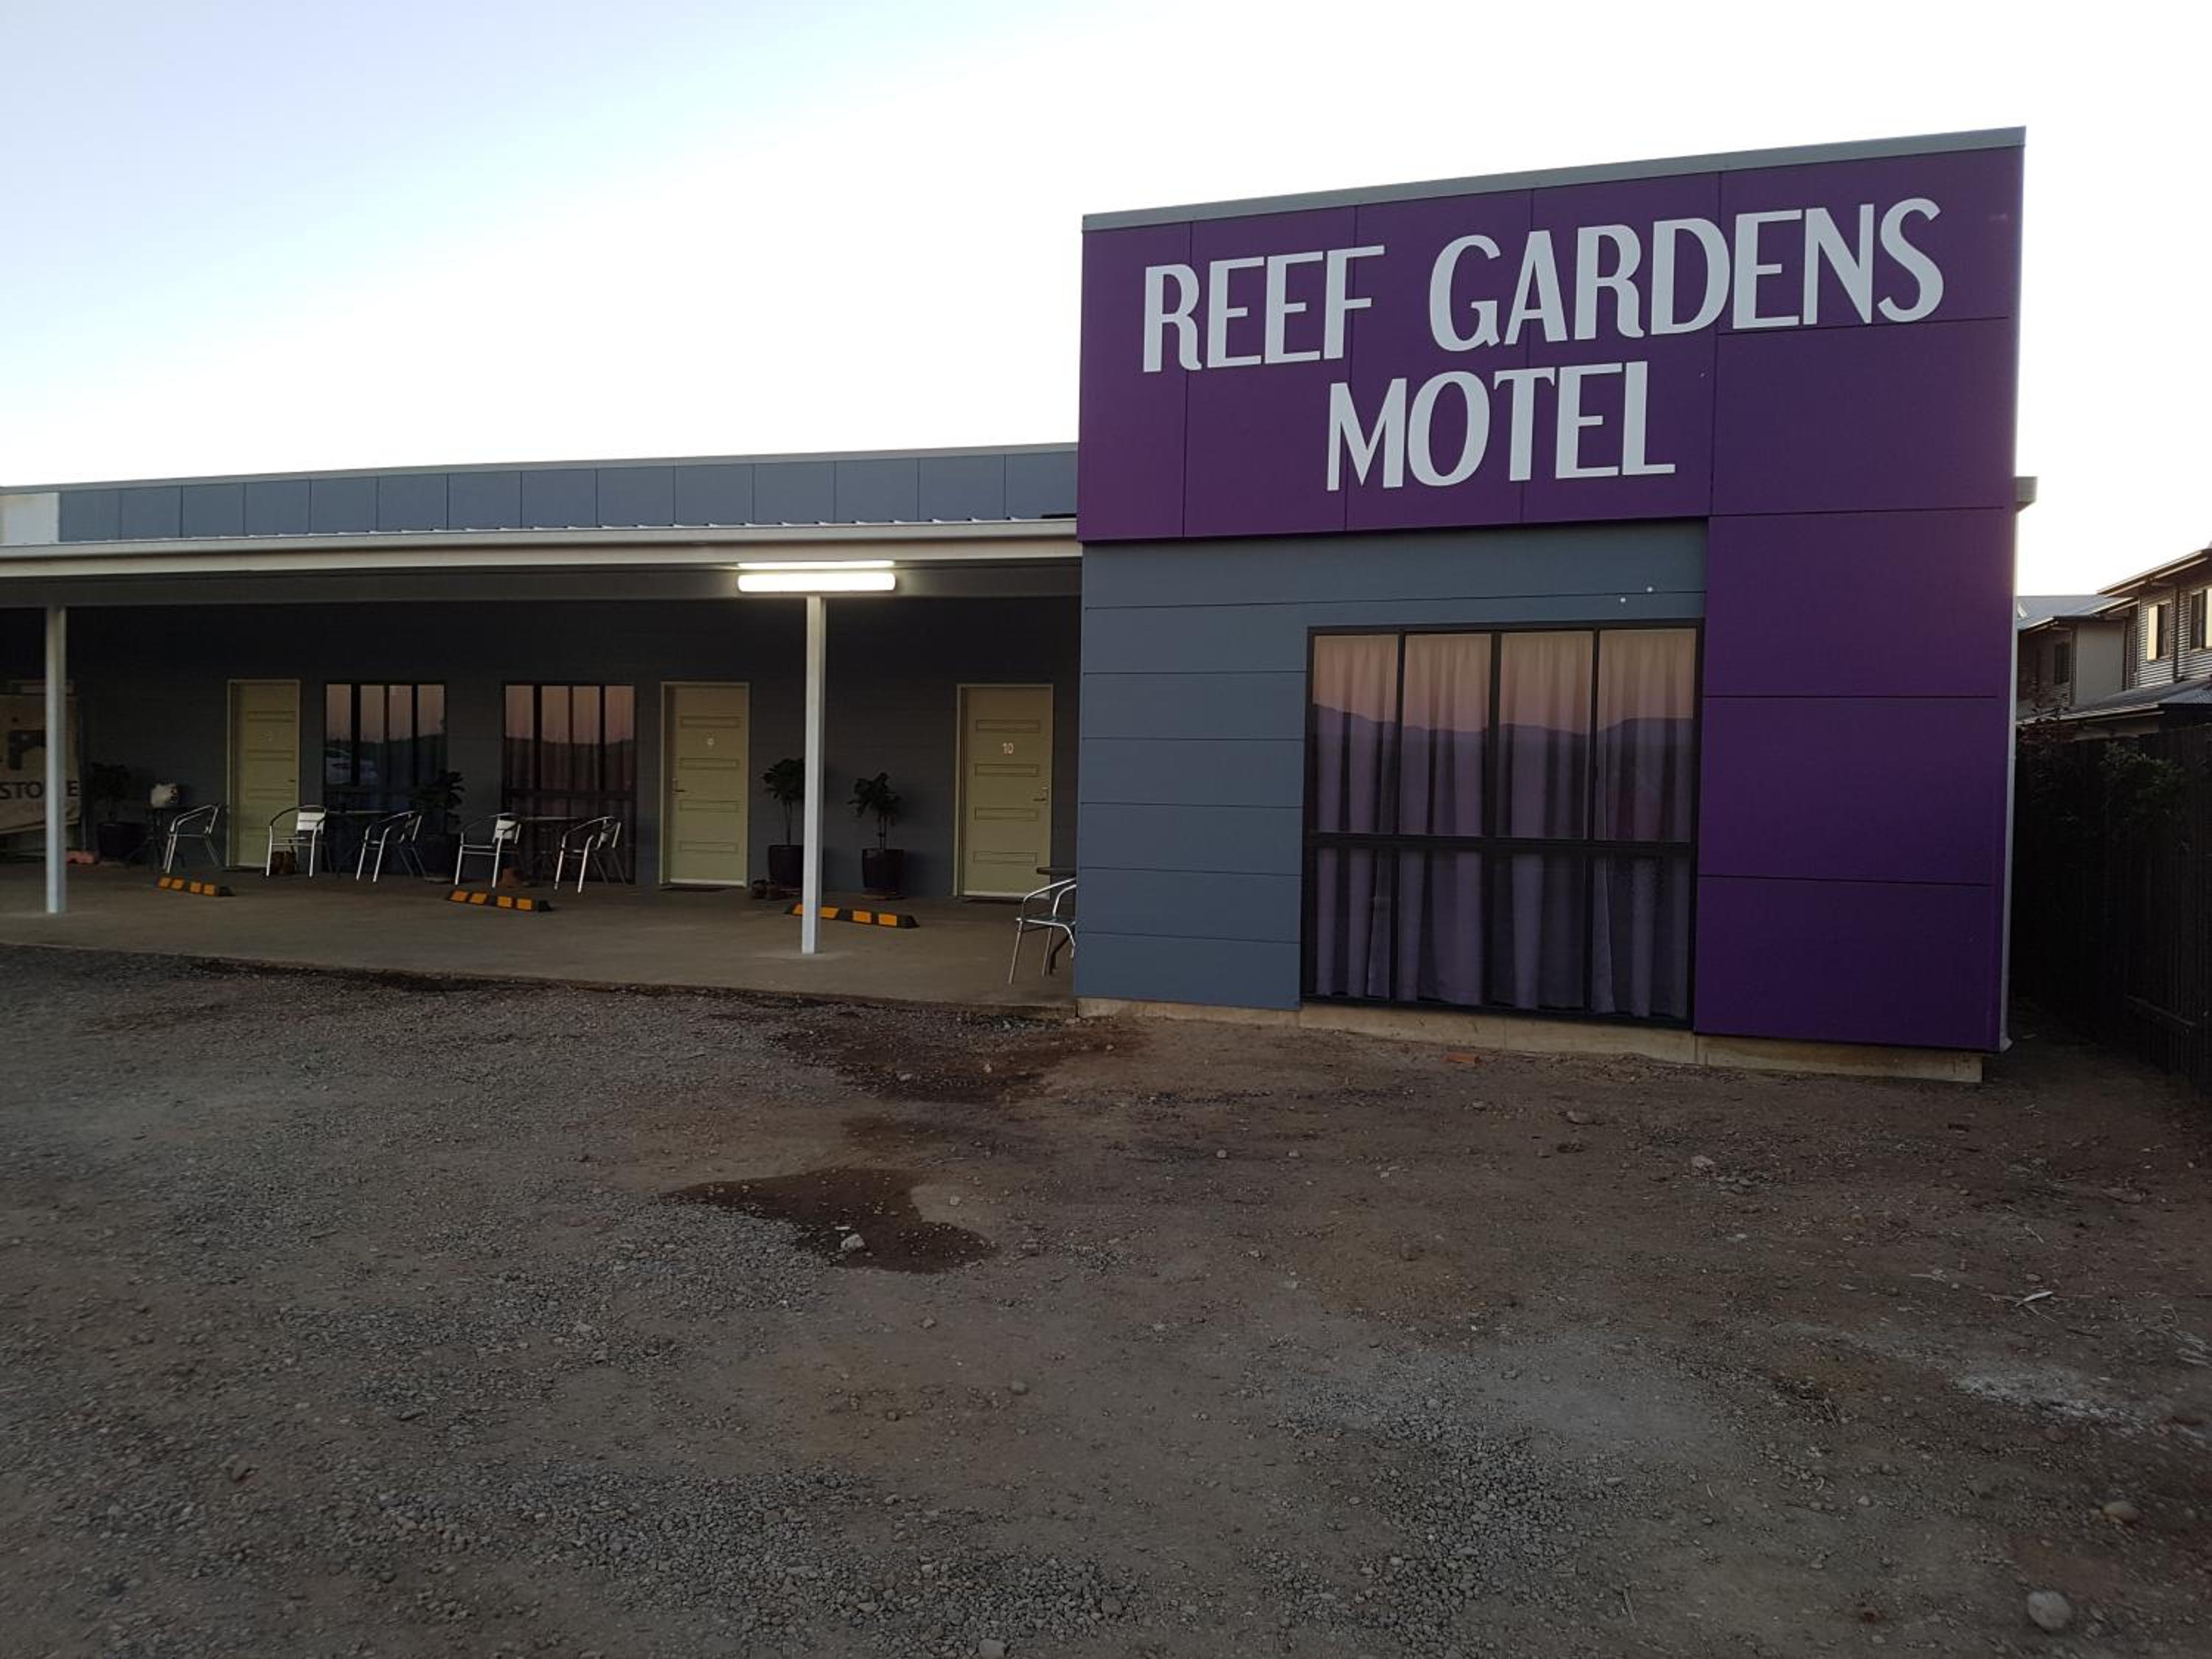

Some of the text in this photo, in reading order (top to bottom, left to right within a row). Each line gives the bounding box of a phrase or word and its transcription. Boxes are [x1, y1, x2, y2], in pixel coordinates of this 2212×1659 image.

[1143, 198, 1944, 372] REEF GARDENS
[1326, 361, 1676, 491] MOTEL
[0, 780, 80, 799] STOE
